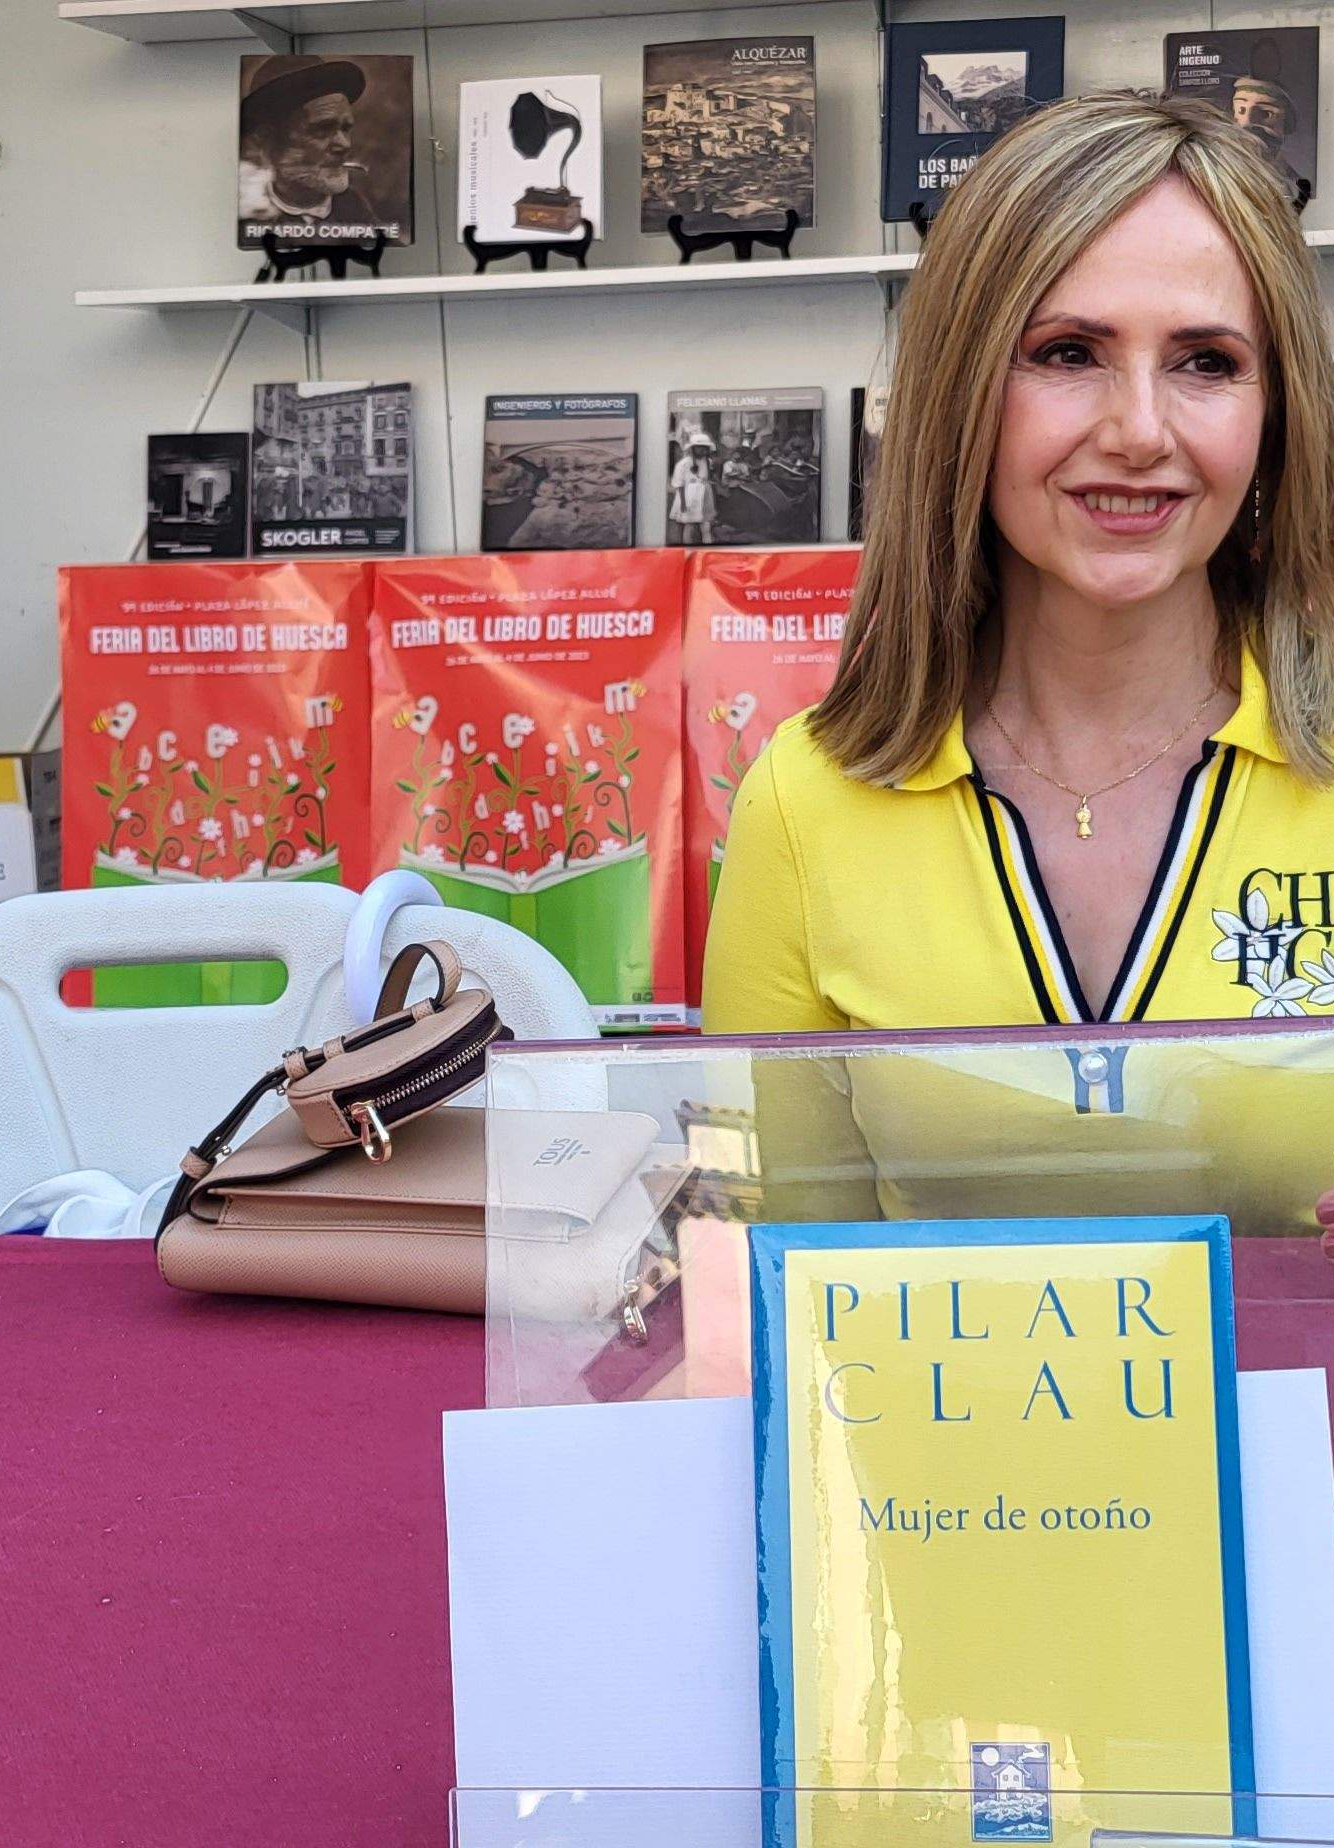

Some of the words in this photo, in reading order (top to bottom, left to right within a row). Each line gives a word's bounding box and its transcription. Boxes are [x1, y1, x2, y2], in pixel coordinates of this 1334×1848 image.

[732, 44, 806, 60] ALQUÉZAR
[1179, 45, 1204, 56] ARTE
[1179, 55, 1220, 66] INGENUO
[919, 159, 946, 173] LOS
[919, 175, 937, 189] DE
[494, 400, 552, 410] INGENIEROS
[555, 401, 560, 409] Y
[564, 398, 626, 409] FOTÓGRAFOS
[261, 527, 342, 547] SKOGLER
[764, 588, 812, 601] EDICIÓN
[392, 617, 440, 648] FERIA
[445, 616, 478, 643] DEL
[483, 615, 541, 642] LIBRO
[546, 614, 573, 641] DE
[577, 610, 655, 640] HUESCA
[710, 614, 767, 642] FERIA
[772, 614, 807, 642] DEL
[813, 613, 849, 641] LIB
[91, 626, 143, 654] FERIA
[147, 625, 180, 653] DEL
[183, 625, 238, 652] LIBRO
[242, 624, 267, 651] DE
[271, 623, 348, 651] HUESCA
[533, 1138, 571, 1167] TOUS
[823, 1276, 1176, 1342] PILAR
[824, 1358, 1175, 1423] CLAU
[859, 1497, 971, 1544] Mujer
[983, 1496, 1025, 1531] de
[1040, 1497, 1151, 1531] otoño
